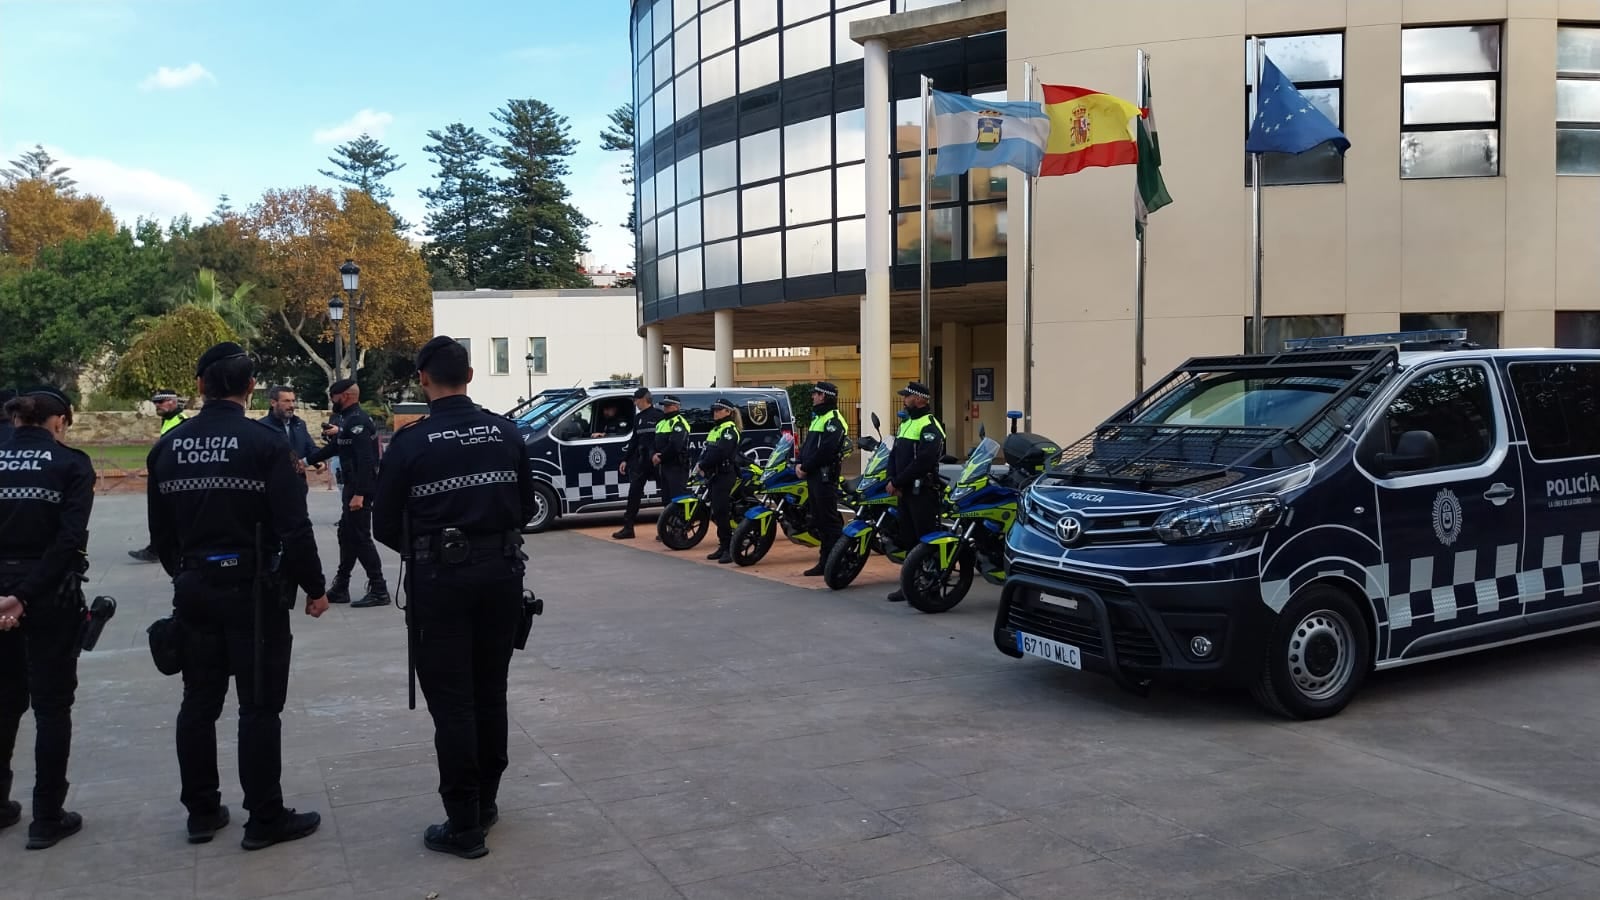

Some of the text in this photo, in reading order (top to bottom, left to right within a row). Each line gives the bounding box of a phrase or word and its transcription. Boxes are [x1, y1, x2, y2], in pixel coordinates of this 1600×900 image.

[427, 425, 501, 442] POLICIA
[460, 435, 503, 445] LOCAL
[172, 436, 239, 451] POLICIA
[177, 449, 230, 464] LOCAL
[1546, 472, 1600, 497] POLICÍA
[1024, 636, 1076, 665] 6710 MLC
